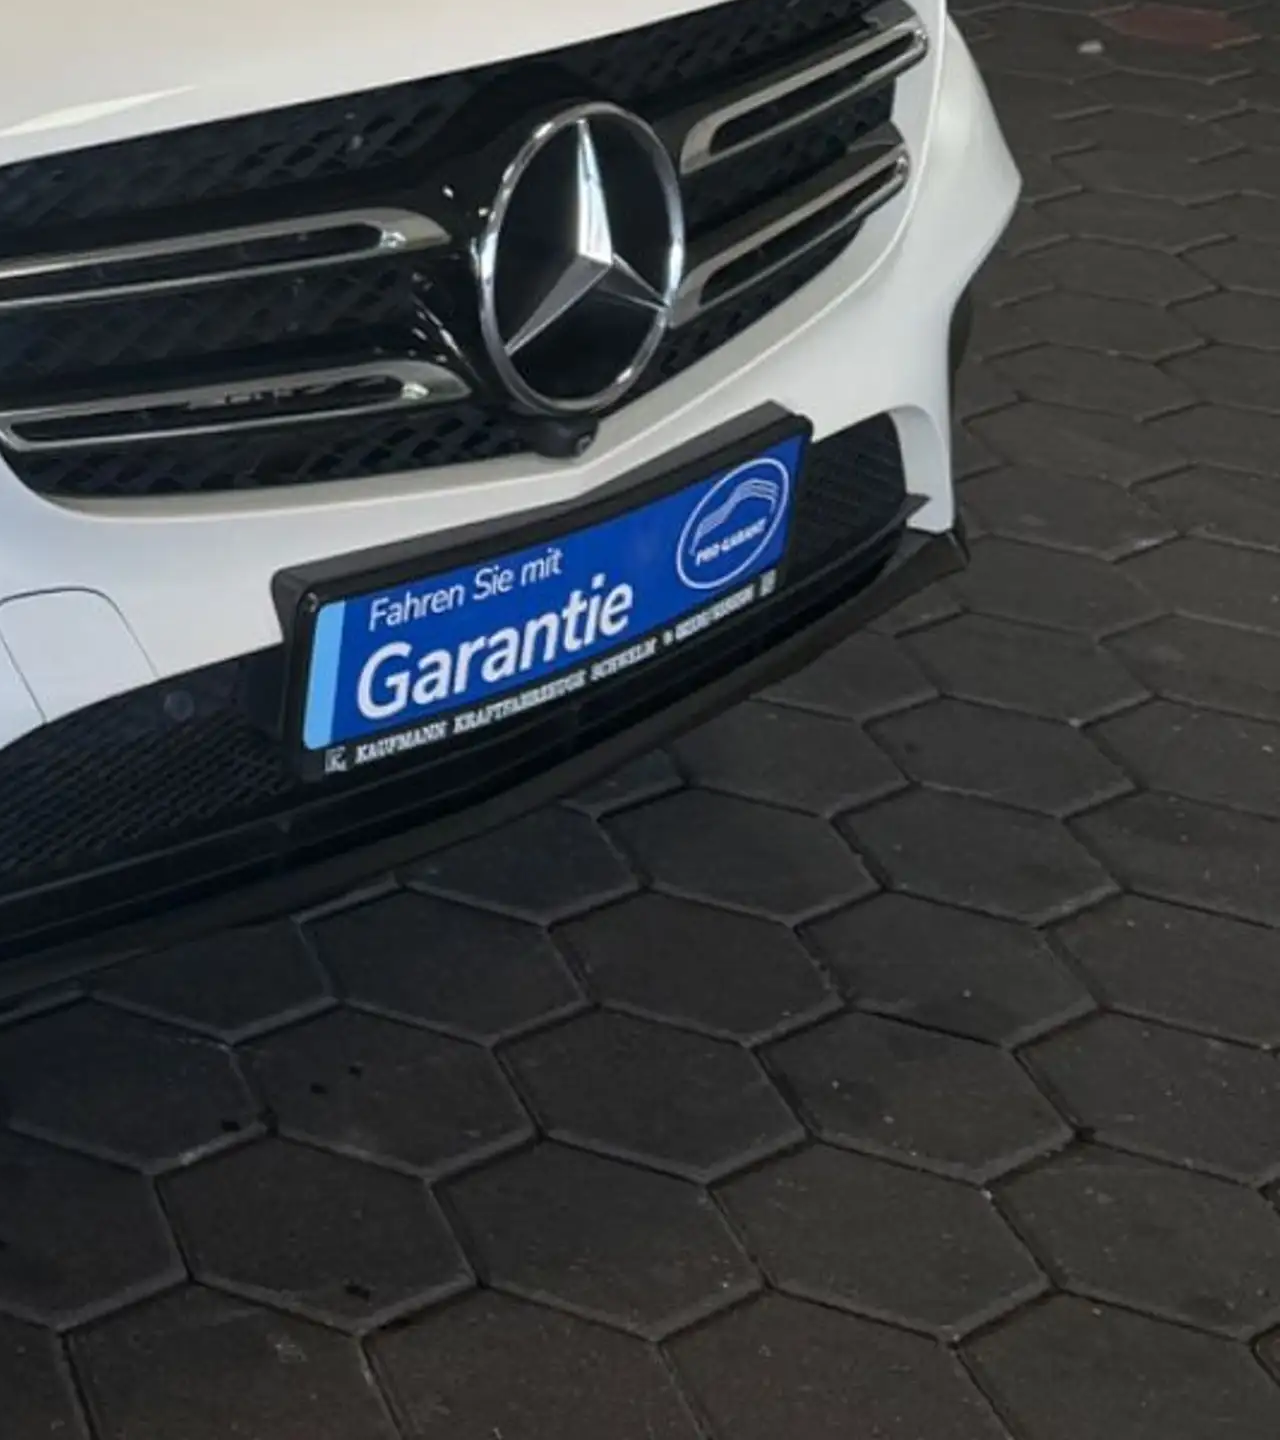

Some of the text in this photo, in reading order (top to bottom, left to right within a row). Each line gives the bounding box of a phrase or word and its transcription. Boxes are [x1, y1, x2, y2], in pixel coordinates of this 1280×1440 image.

[369, 547, 563, 631] Fahren Sie mit
[357, 573, 633, 720] Garantie
[355, 719, 449, 764] KAUFMANN
